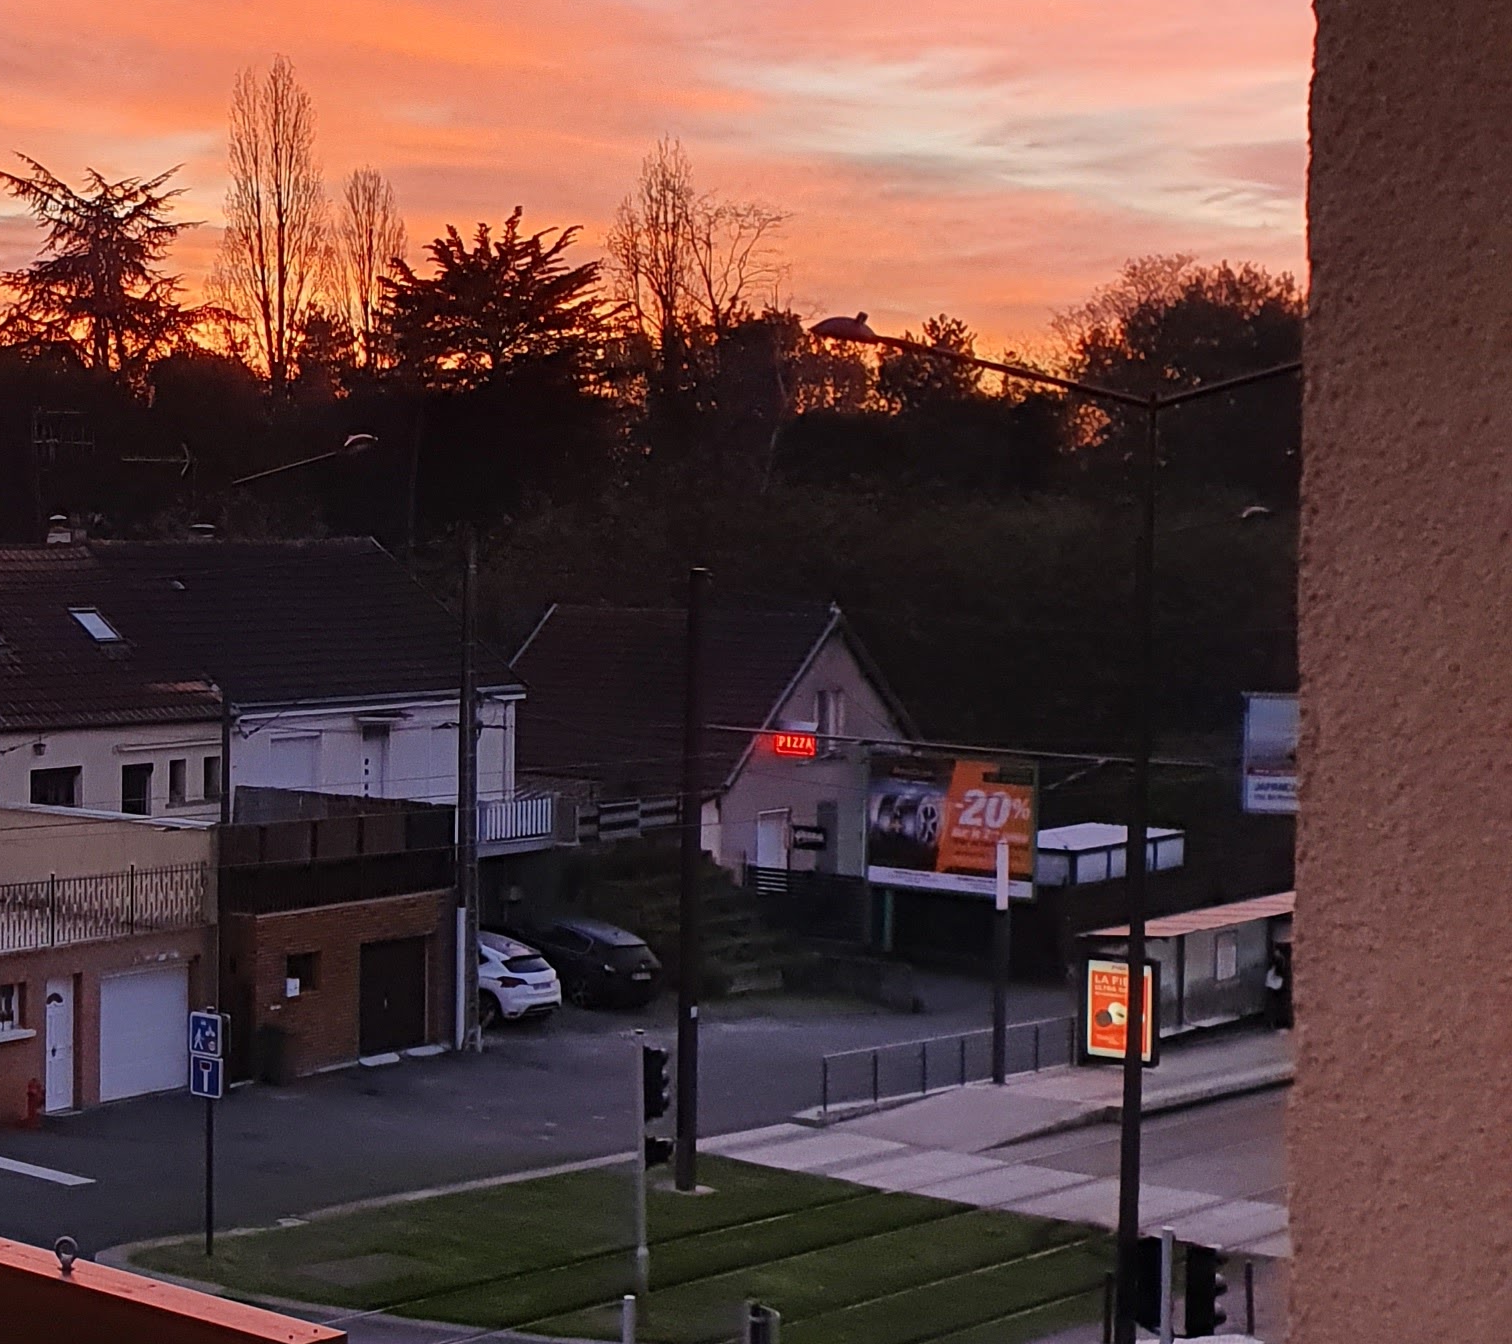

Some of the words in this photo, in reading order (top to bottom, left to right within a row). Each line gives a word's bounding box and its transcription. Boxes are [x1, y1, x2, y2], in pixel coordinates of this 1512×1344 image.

[778, 735, 814, 749] PIZZA
[955, 788, 1031, 829] -20%
[1095, 974, 1109, 985] LA
